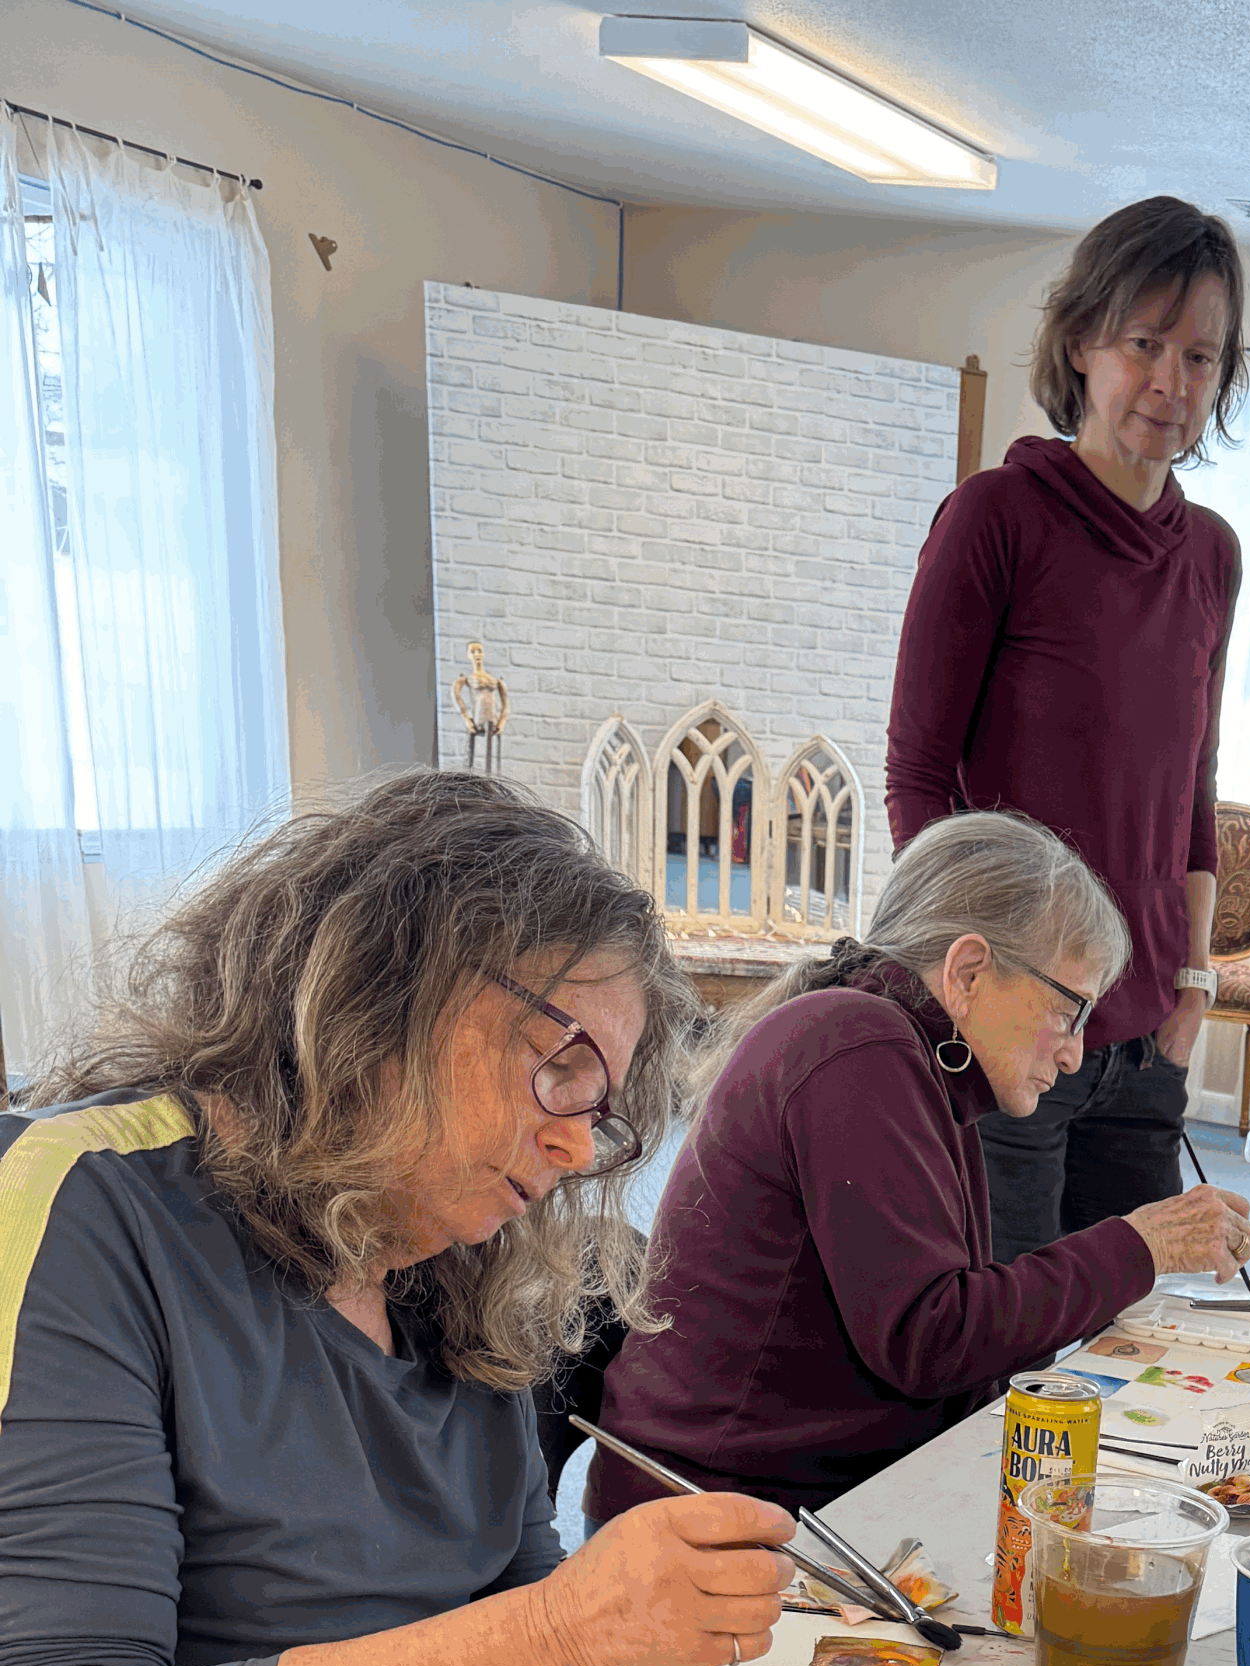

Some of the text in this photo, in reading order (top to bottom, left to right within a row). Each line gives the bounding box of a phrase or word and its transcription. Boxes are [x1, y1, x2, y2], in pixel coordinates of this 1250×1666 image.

[1011, 1422, 1072, 1457] AURA
[1206, 1444, 1246, 1461] Berry
[1009, 1450, 1072, 1487] BO
[1189, 1458, 1229, 1480] Nutty
